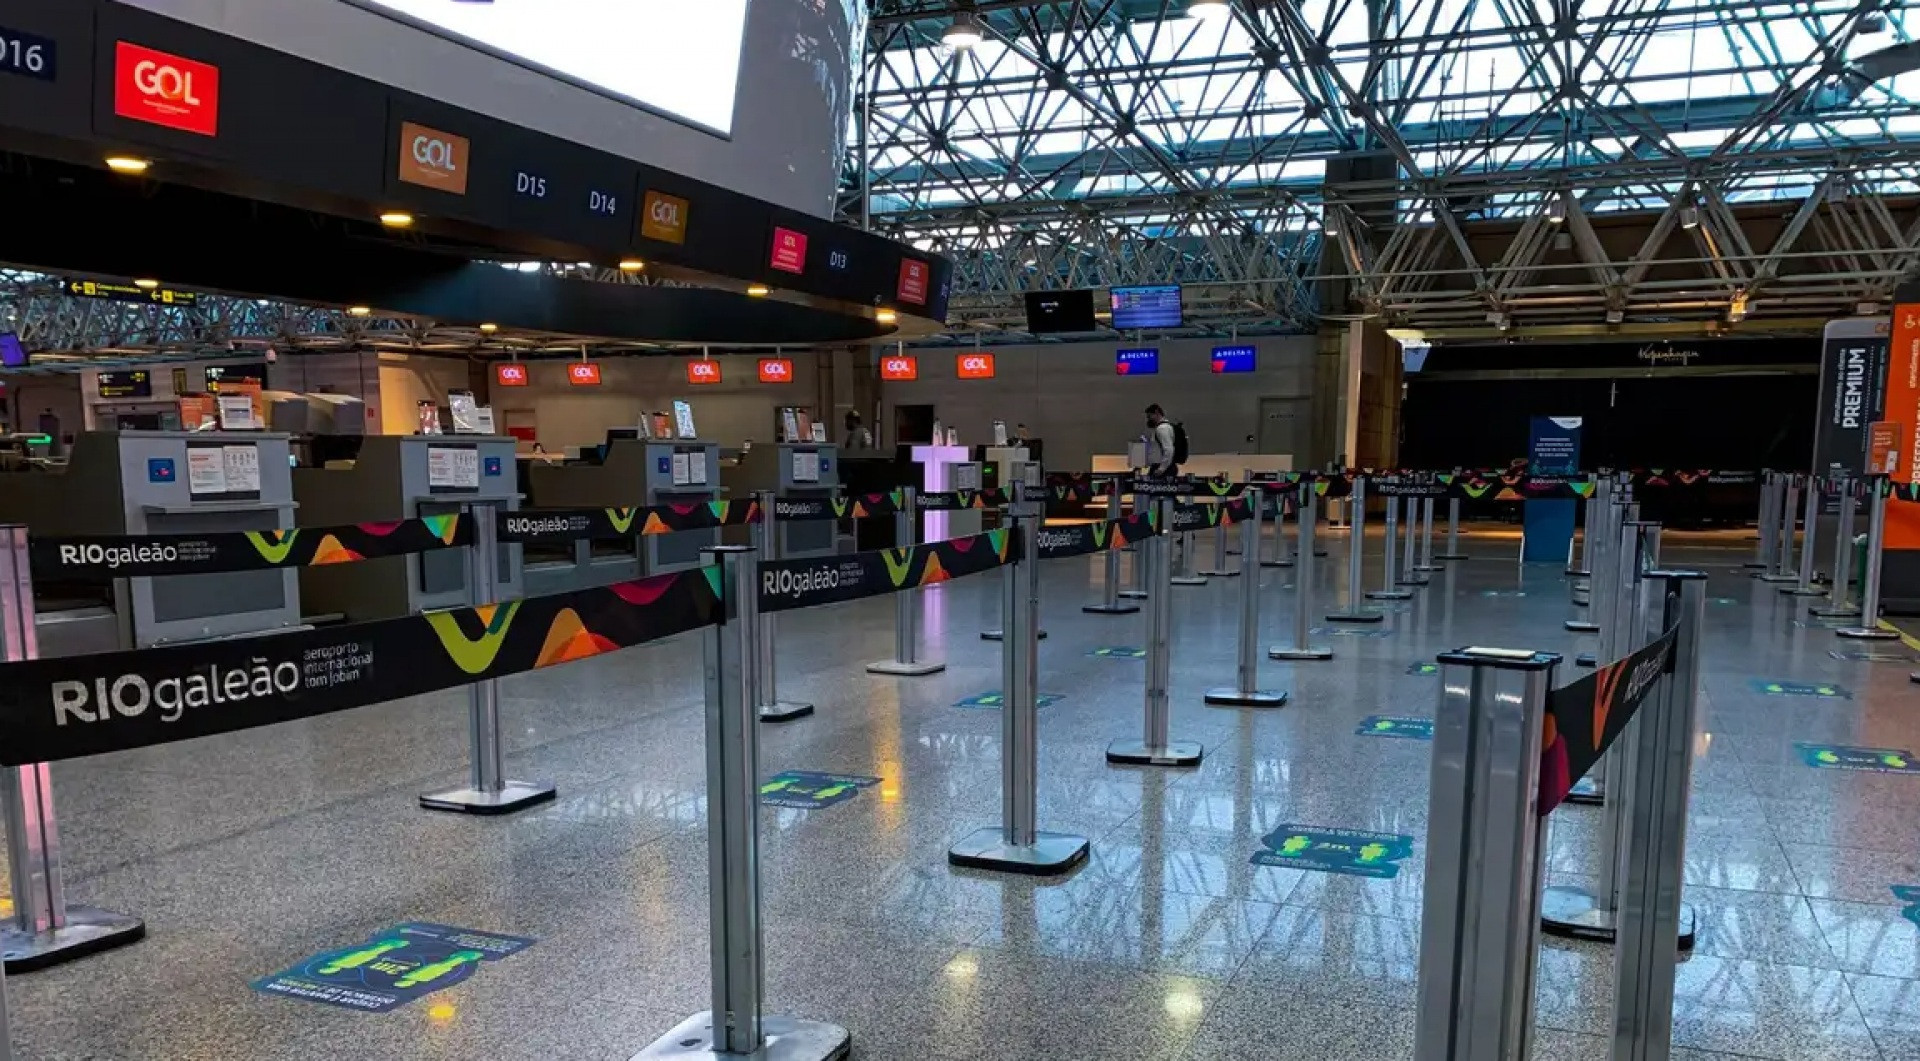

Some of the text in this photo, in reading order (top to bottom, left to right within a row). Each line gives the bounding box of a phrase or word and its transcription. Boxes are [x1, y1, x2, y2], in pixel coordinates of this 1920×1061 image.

[134, 60, 200, 106] GOL
[412, 136, 456, 170] GOL
[516, 172, 546, 198] D15
[589, 190, 616, 216] D14
[651, 199, 680, 227] GOL
[829, 250, 846, 269] D13
[502, 368, 522, 380] GOL
[574, 367, 594, 378] GOL
[693, 364, 714, 376] GOL
[764, 363, 785, 375] GOL
[887, 359, 909, 371] GOL
[963, 357, 987, 371] GOL
[1842, 348, 1866, 430] PREMIUM
[507, 516, 569, 536] RIOgaleão
[59, 542, 177, 570] RIOgaleão
[763, 565, 840, 599] RIOgaleão
[302, 643, 360, 661] aeroporto
[303, 651, 374, 676] internacional
[304, 668, 360, 690] tom jobim
[51, 656, 299, 727] RIOgaleão
